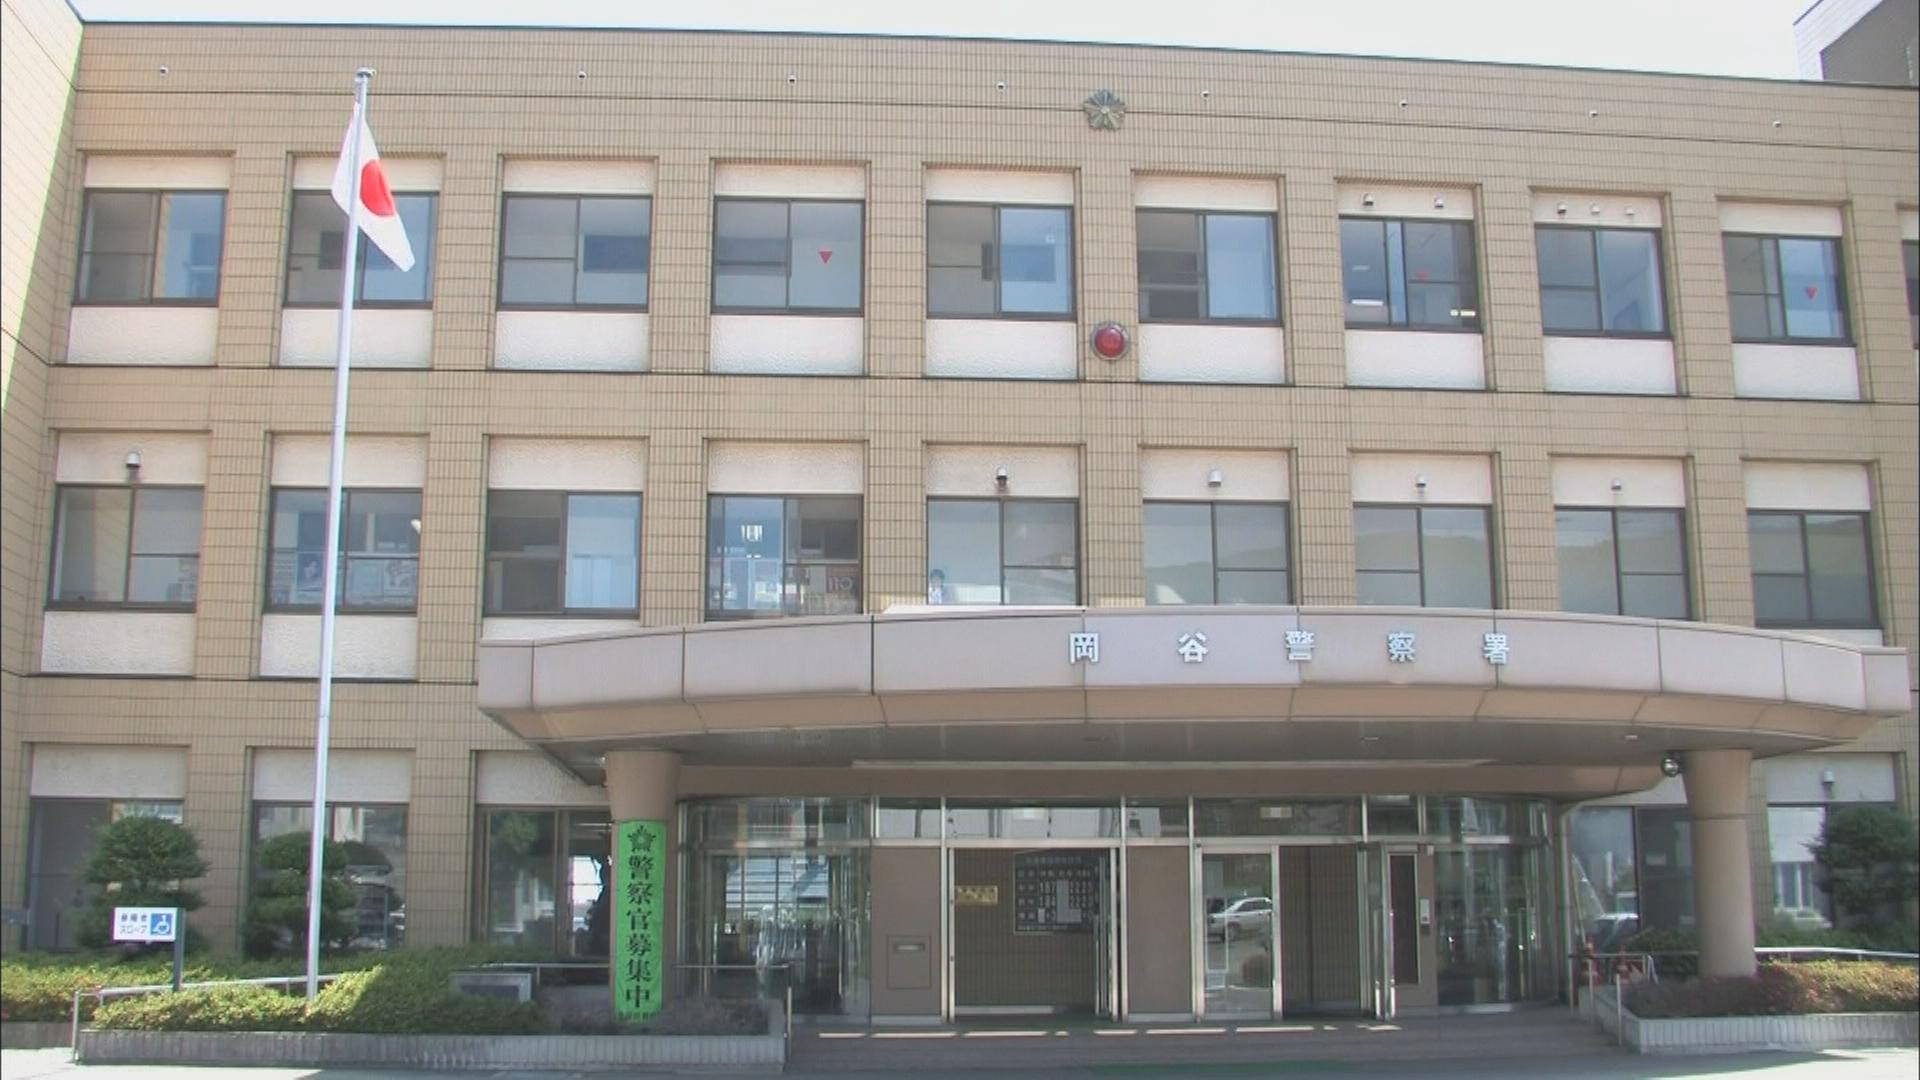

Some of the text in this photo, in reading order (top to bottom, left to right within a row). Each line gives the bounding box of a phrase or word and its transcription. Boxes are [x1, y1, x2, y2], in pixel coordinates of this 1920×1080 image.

[1068, 630, 1511, 666] 岡谷警察署
[119, 924, 148, 935] スロープ
[625, 855, 655, 1009] 警察官募集中
